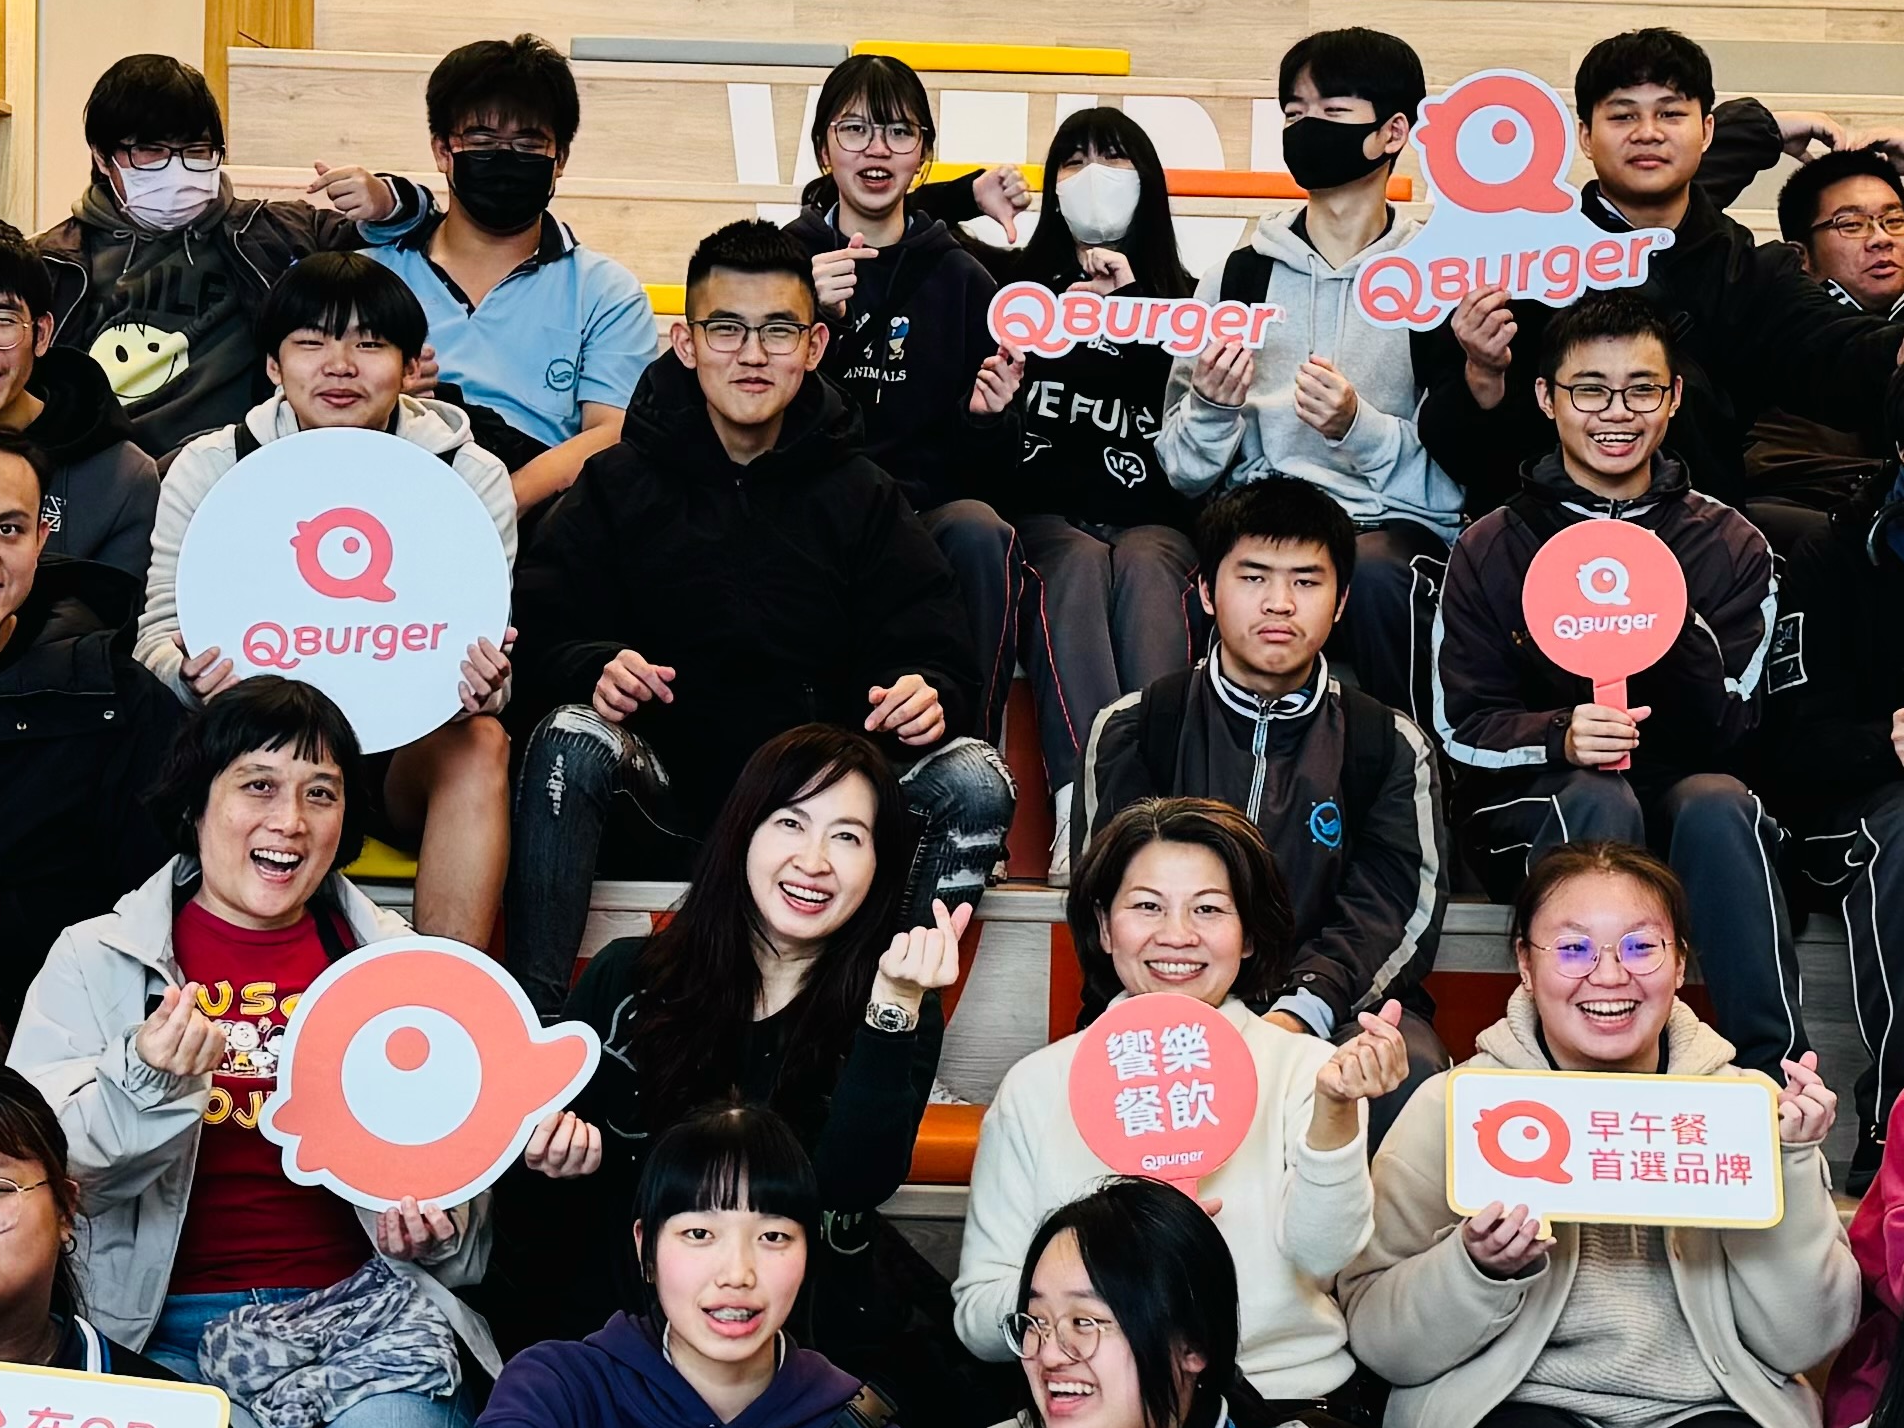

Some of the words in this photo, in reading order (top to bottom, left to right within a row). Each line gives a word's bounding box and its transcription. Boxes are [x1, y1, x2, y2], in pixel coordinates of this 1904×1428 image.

[1358, 234, 1654, 325] QBurger
[992, 286, 1276, 353] QBurger
[843, 365, 908, 382] ANIMALS
[242, 621, 449, 670] QBurger
[1552, 611, 1659, 641] QBurger
[1105, 1022, 1212, 1082] 饗樂
[1114, 1078, 1220, 1138] 餐飲
[1587, 1110, 1709, 1146] 早午餐
[1141, 1149, 1205, 1171] QBurger
[1587, 1148, 1753, 1186] 首選品牌
